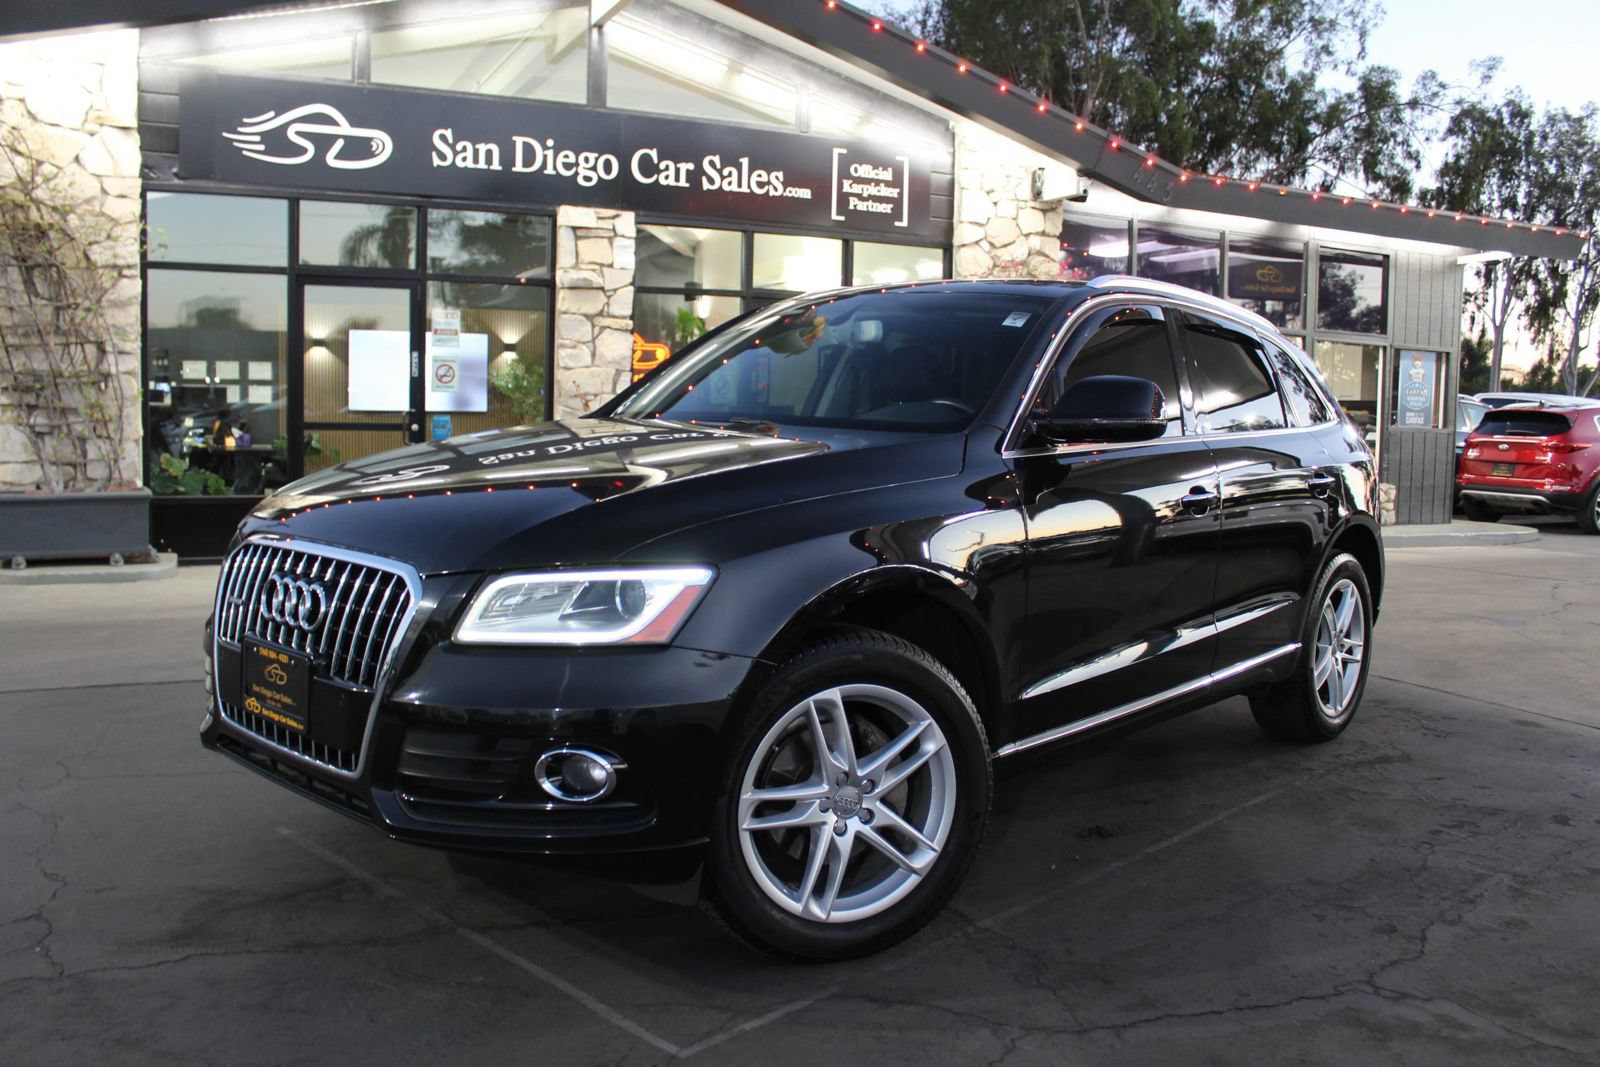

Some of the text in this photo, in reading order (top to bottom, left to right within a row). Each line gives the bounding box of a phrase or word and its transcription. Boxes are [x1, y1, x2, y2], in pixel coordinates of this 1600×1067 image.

[431, 127, 811, 199] San Diego Car Sales.com
[849, 163, 893, 180] Official
[842, 180, 900, 198] Karpicker
[849, 197, 893, 213] Partner
